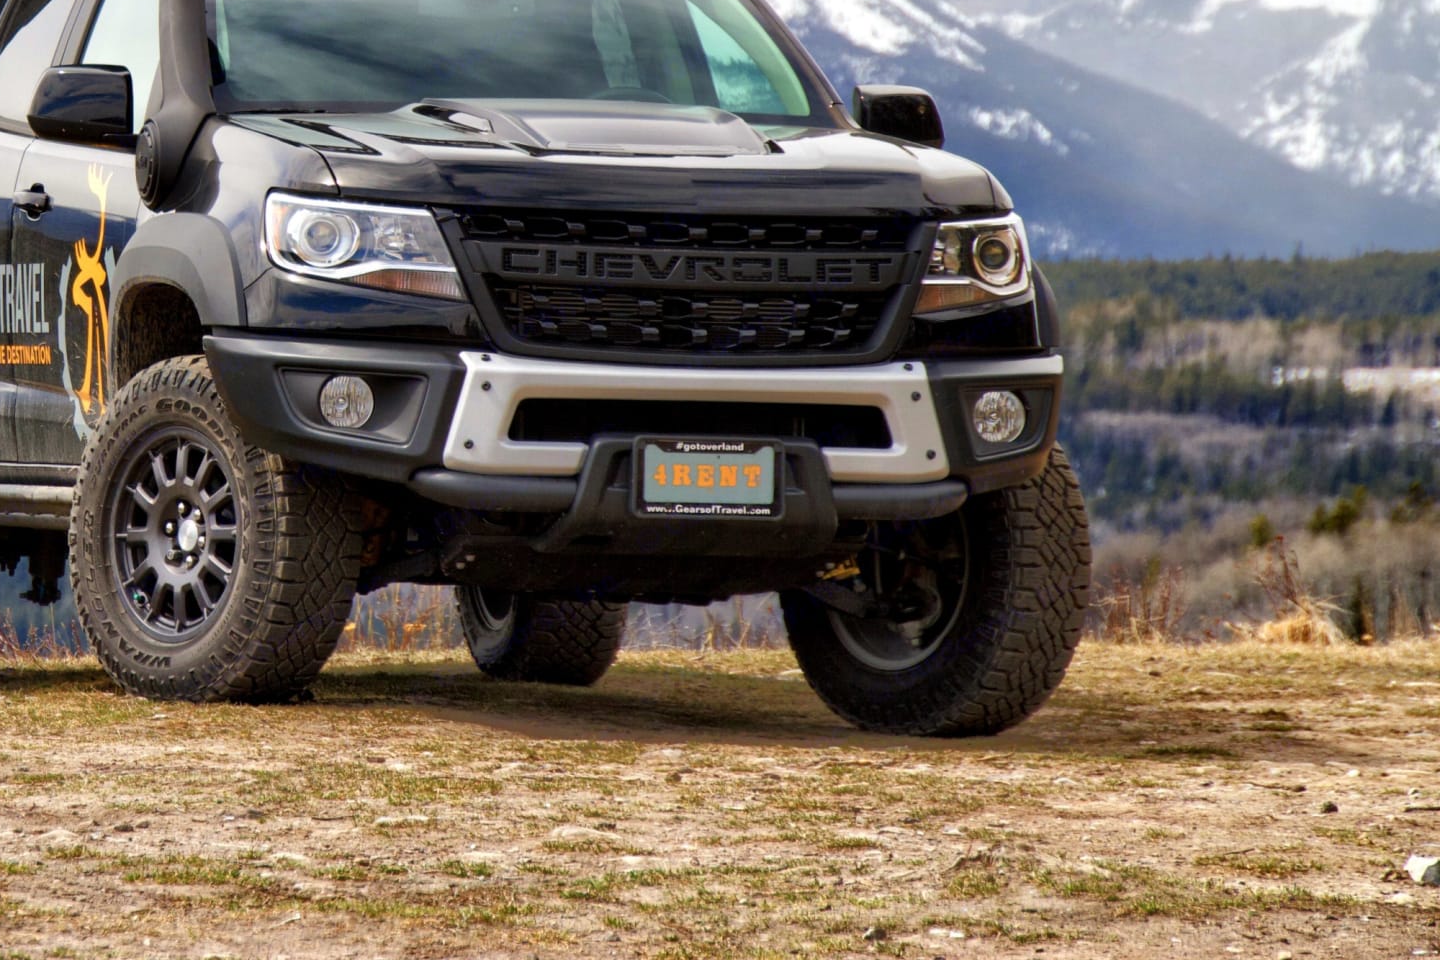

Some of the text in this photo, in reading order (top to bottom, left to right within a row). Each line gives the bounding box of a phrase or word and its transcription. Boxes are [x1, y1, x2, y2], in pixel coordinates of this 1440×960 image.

[502, 247, 891, 284] CHEVROLET
[6, 345, 52, 365] DESTINATION
[676, 443, 744, 452] #gotoverland
[155, 397, 252, 563] GOODYEAR
[654, 463, 762, 487] 4RENT
[83, 510, 172, 668] WRANGLER
